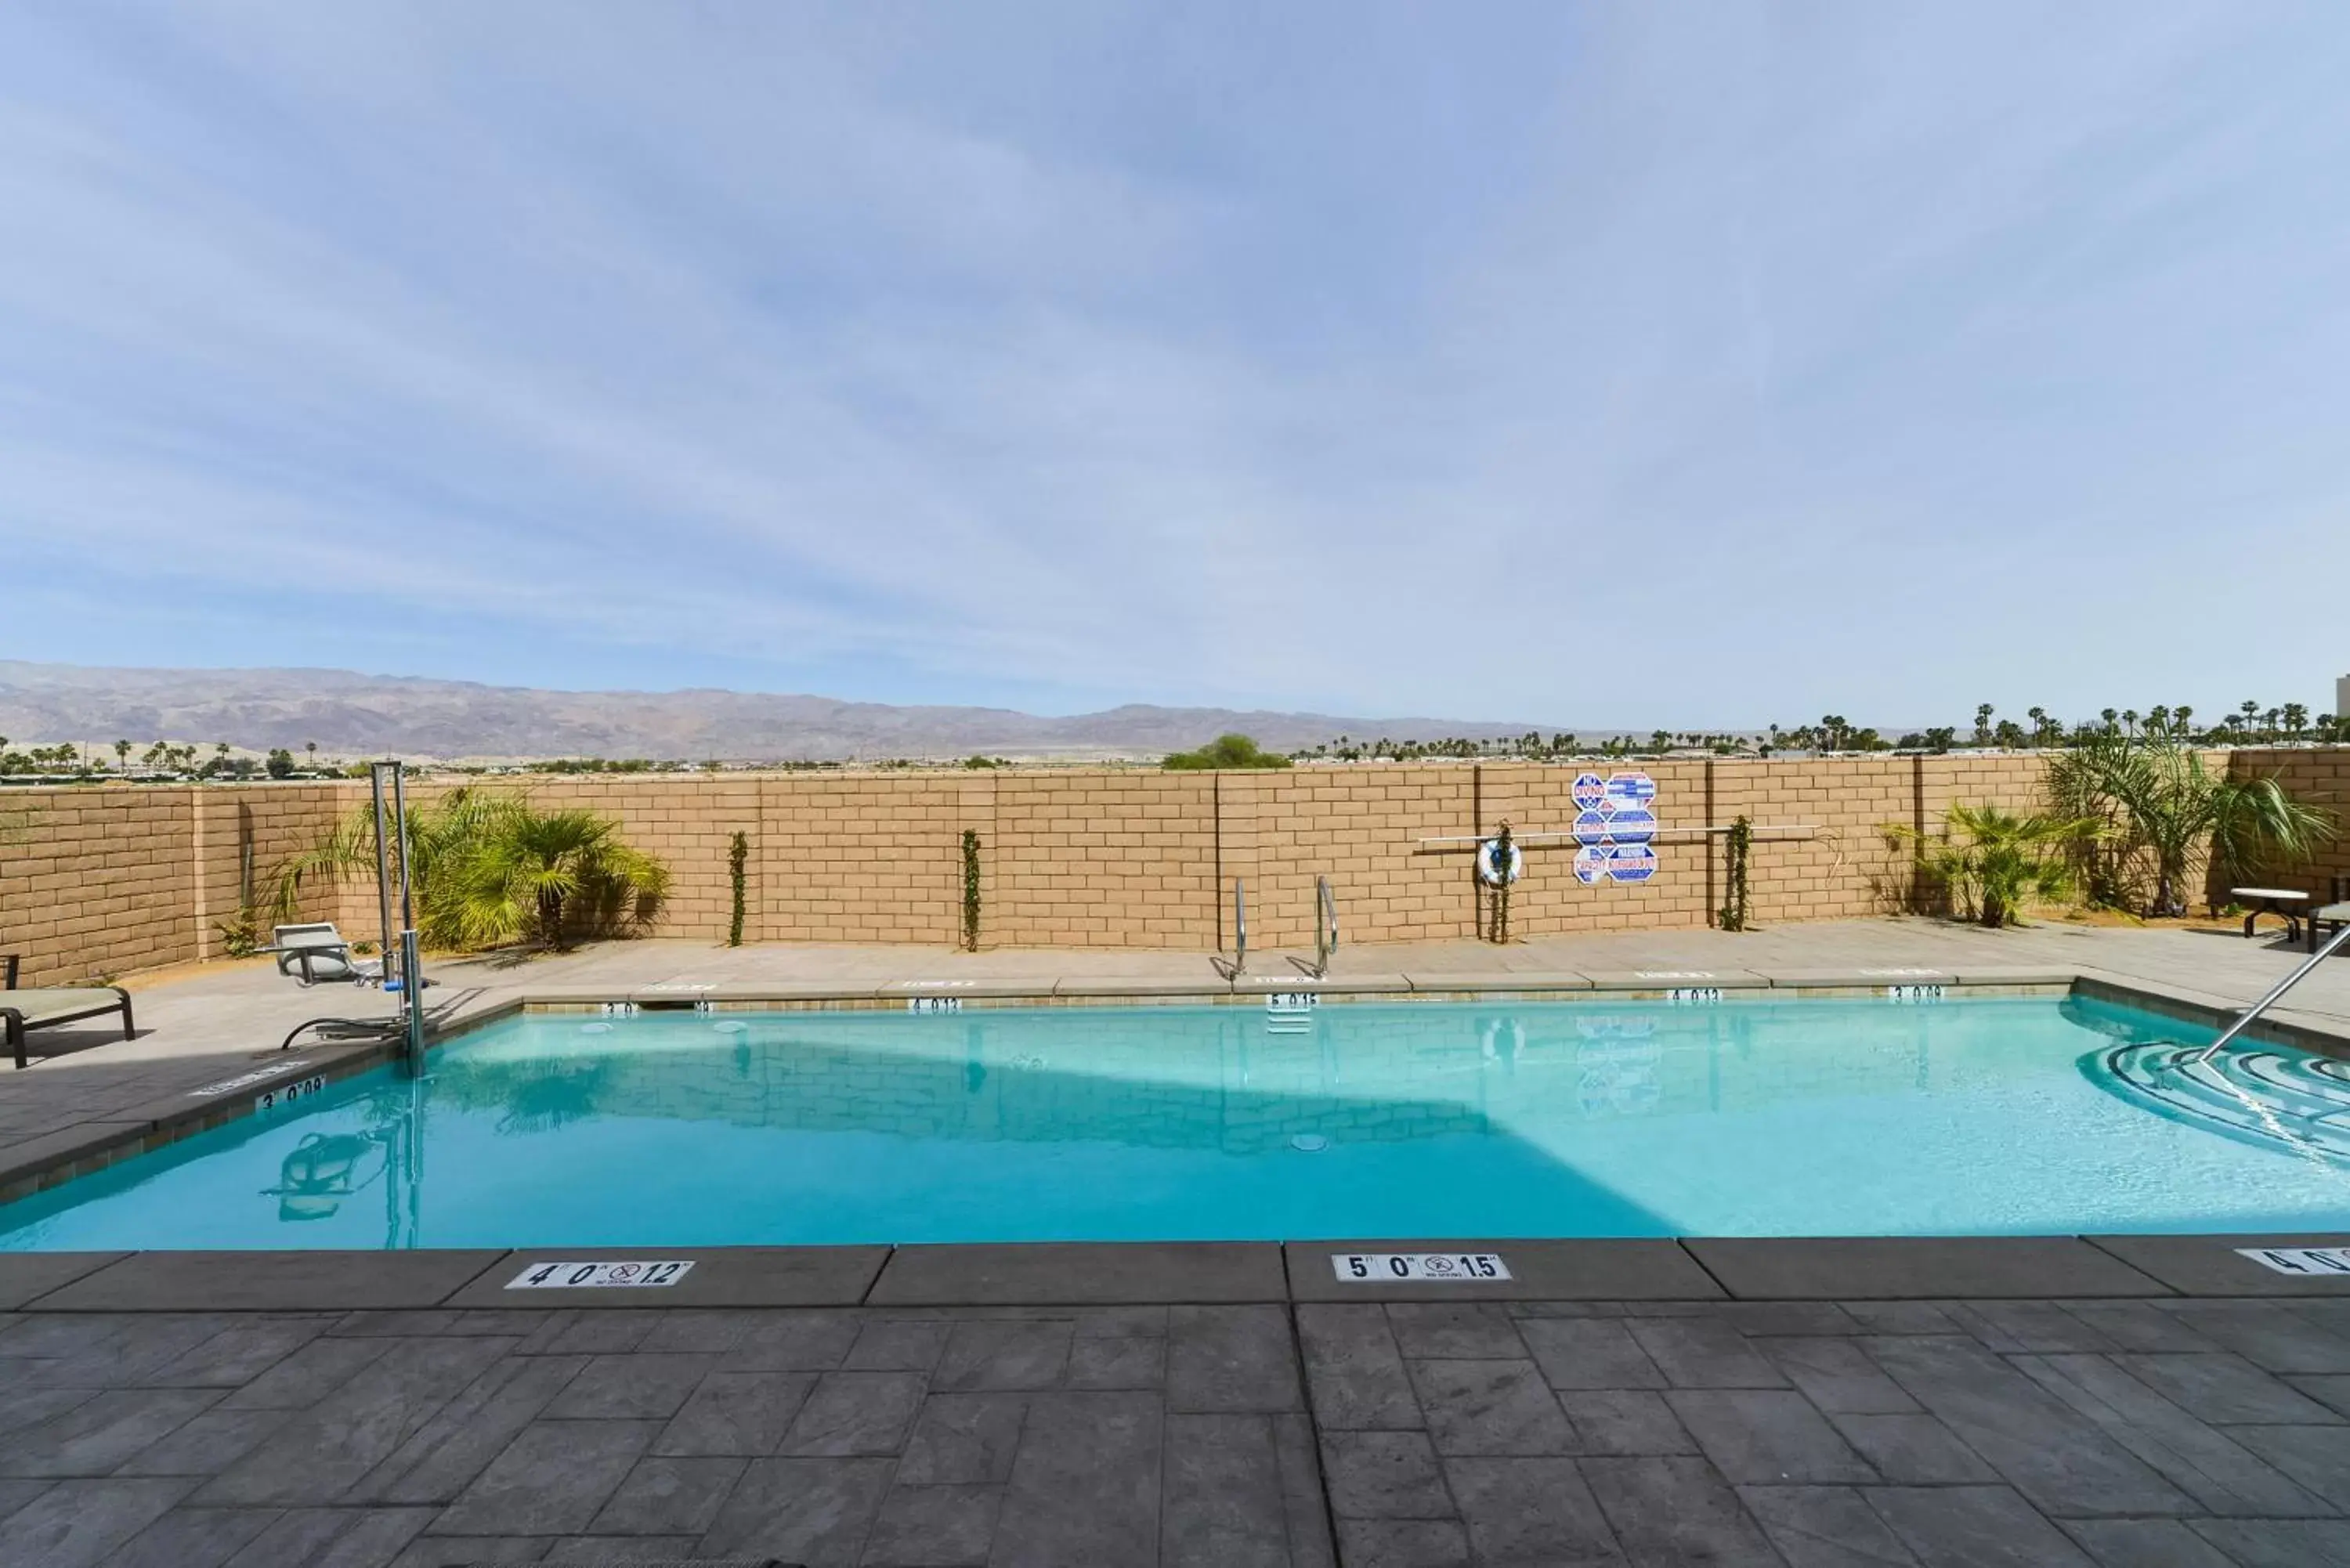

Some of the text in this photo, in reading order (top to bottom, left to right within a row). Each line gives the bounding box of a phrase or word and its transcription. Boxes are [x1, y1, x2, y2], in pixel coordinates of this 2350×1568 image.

[1583, 774, 1596, 786] NO
[1574, 786, 1605, 797] DIVING
[1577, 860, 1607, 871] CAPACITY
[1348, 1256, 1368, 1277] 5
[1389, 1256, 1409, 1277] 0
[2261, 1251, 2309, 1273] 4
[527, 1265, 559, 1285] 4
[568, 1264, 597, 1285] 0
